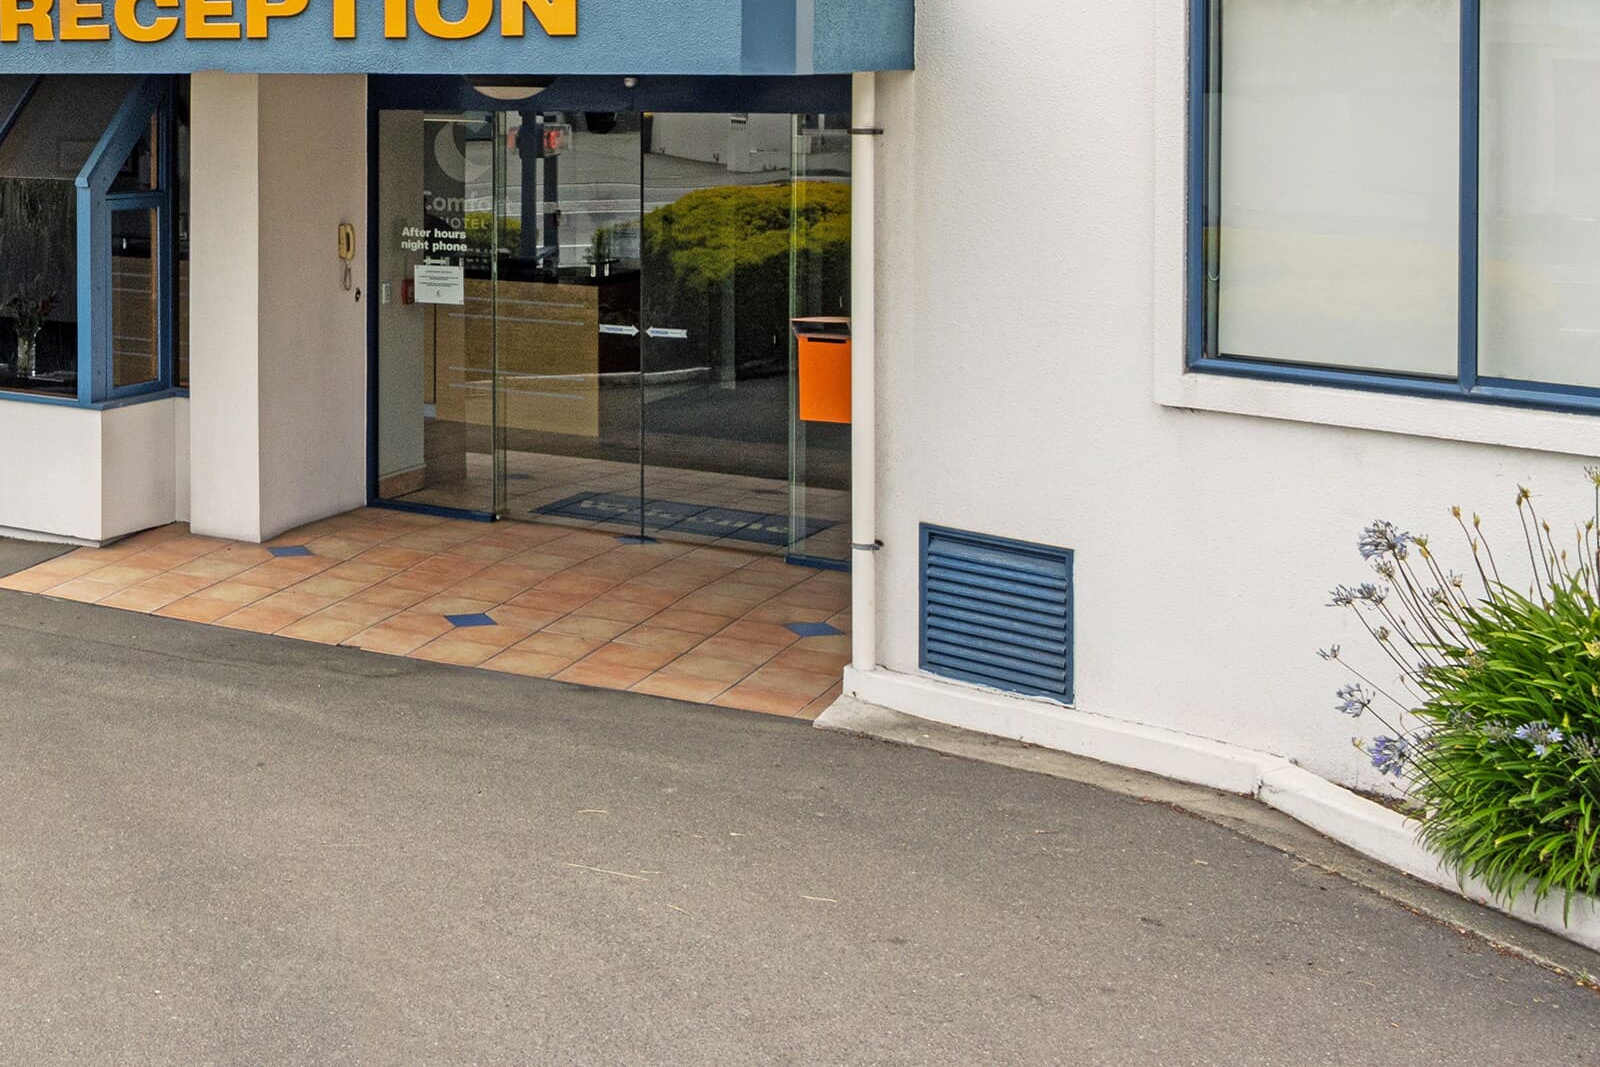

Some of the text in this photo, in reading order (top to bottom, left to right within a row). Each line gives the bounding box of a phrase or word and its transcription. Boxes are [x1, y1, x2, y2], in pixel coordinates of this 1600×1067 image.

[401, 226, 466, 239] After hours
[401, 239, 467, 252] night phone
